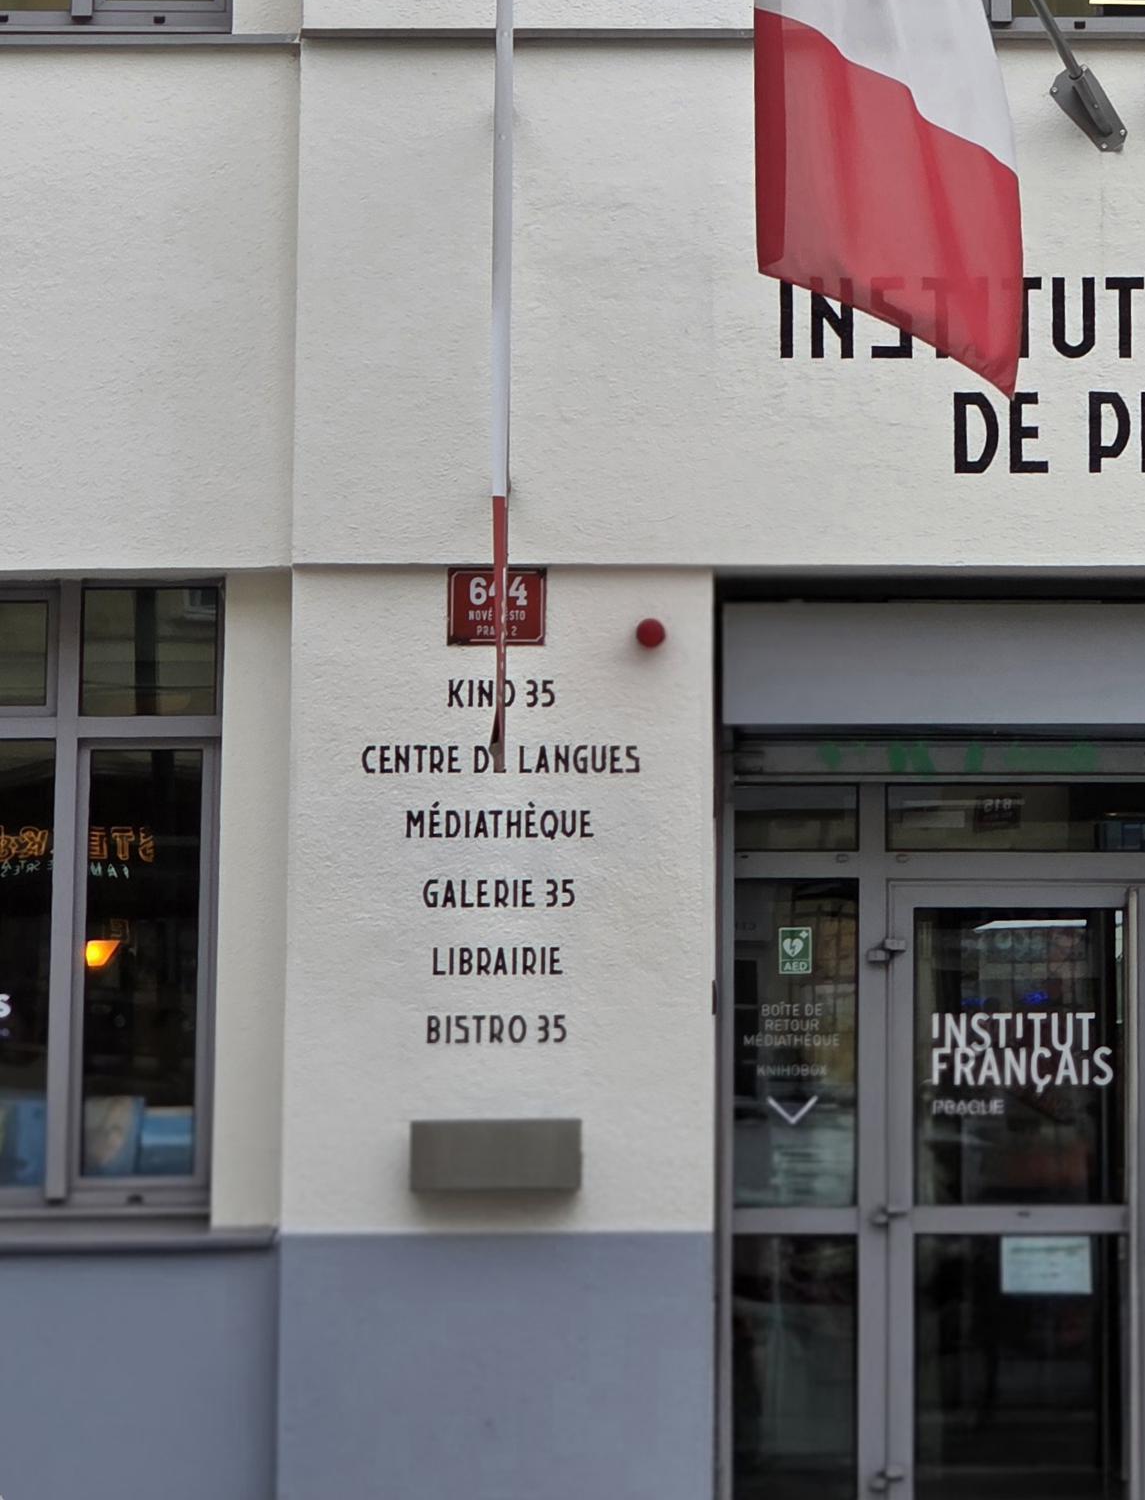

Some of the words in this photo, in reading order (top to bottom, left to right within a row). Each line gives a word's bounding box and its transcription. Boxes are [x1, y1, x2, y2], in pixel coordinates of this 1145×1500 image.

[953, 391, 1049, 475] DE
[468, 607, 493, 621] NOVÉ
[477, 625, 508, 637] PRA
[511, 625, 518, 637] 2
[447, 678, 516, 708] KINO
[526, 679, 556, 708] 35
[361, 744, 462, 774] CENTRE
[473, 745, 507, 774] D
[518, 744, 641, 774] LANGUES
[405, 801, 595, 840] MÉDIATHÈQUE
[422, 878, 536, 909] GALERIE
[545, 878, 576, 908] 35
[432, 946, 564, 976] LIBRAIRIE
[783, 961, 808, 972] AED
[761, 1001, 800, 1017] BOÎTE
[804, 1003, 823, 1017] DE
[426, 1014, 528, 1044] BISTRO
[538, 1014, 568, 1044] 35
[764, 1019, 820, 1032] RETOUR
[931, 1012, 1096, 1052] INSTITUT
[756, 1064, 828, 1077] KNIHOBOX
[931, 1099, 1006, 1116] PRAGUE
